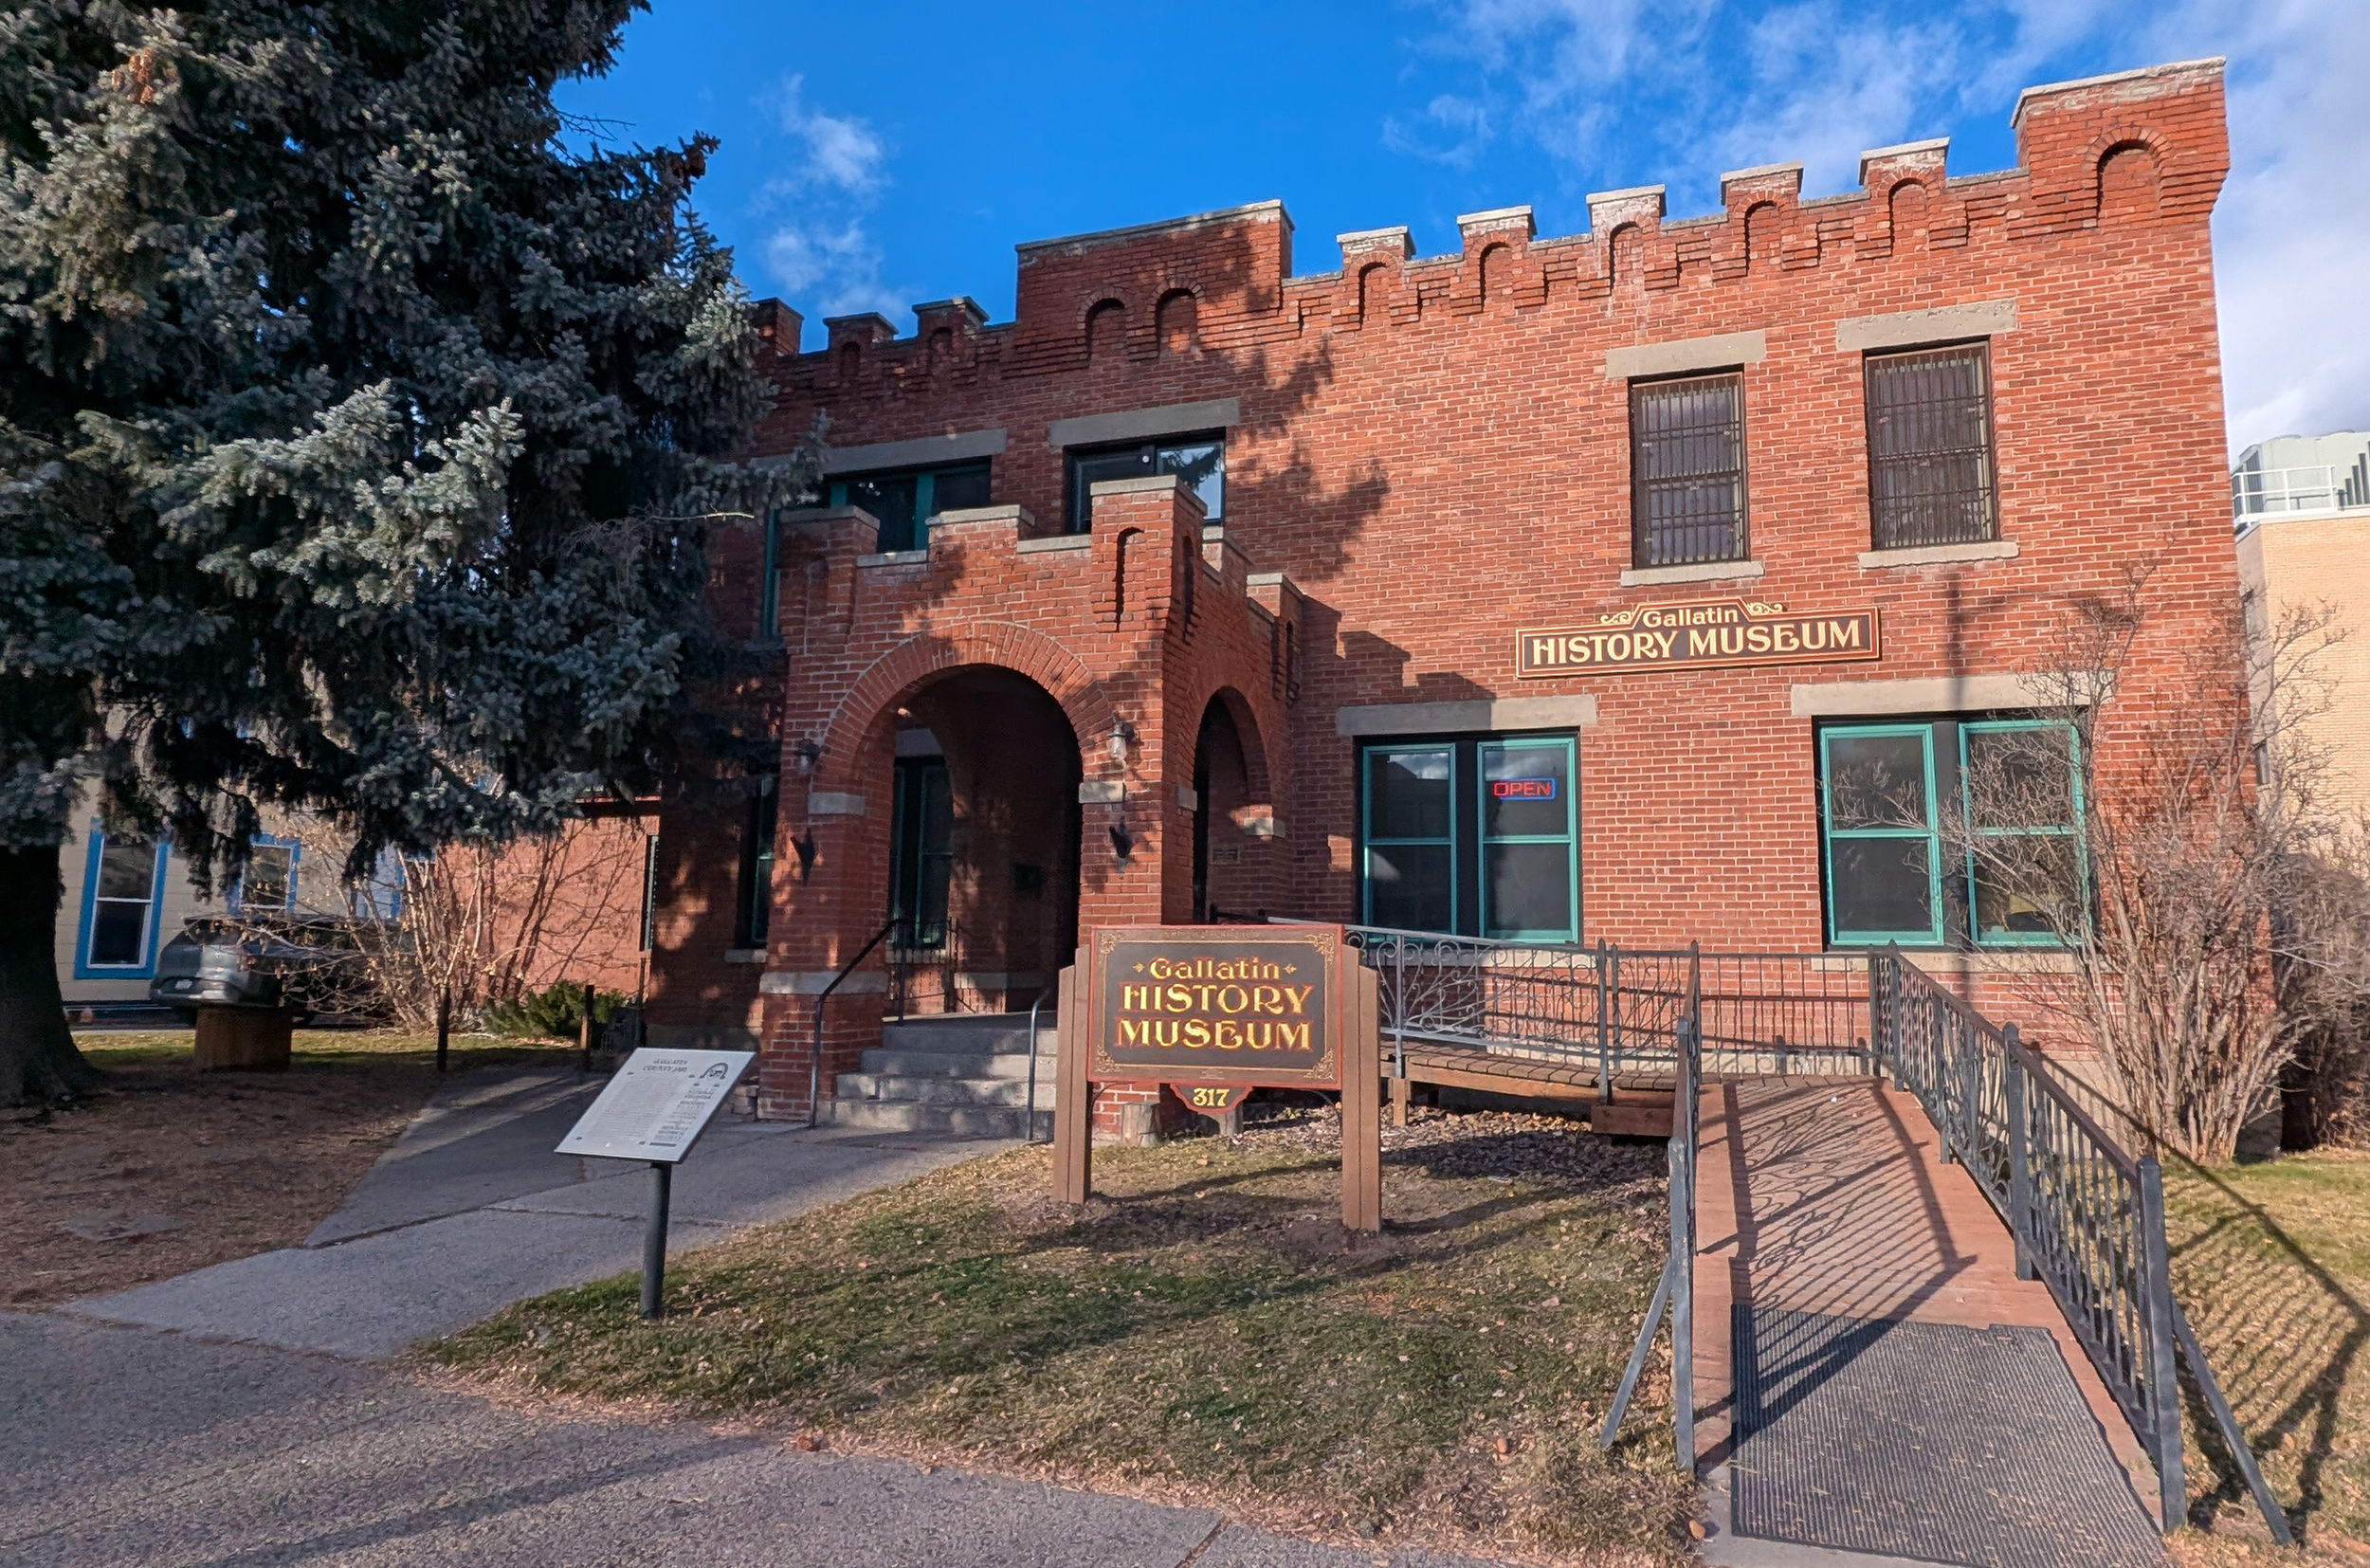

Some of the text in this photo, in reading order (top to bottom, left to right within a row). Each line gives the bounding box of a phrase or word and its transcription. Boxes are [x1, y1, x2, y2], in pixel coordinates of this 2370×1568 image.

[1642, 607, 1739, 629] Gallatin
[1532, 619, 1861, 665] HISTORY MUSEUM
[1493, 781, 1551, 796] OPEN
[1149, 957, 1280, 980] Gallatin
[1122, 983, 1314, 1014] HISTORY
[1117, 1018, 1313, 1051] MUSEUM
[1193, 1087, 1230, 1107] 317
